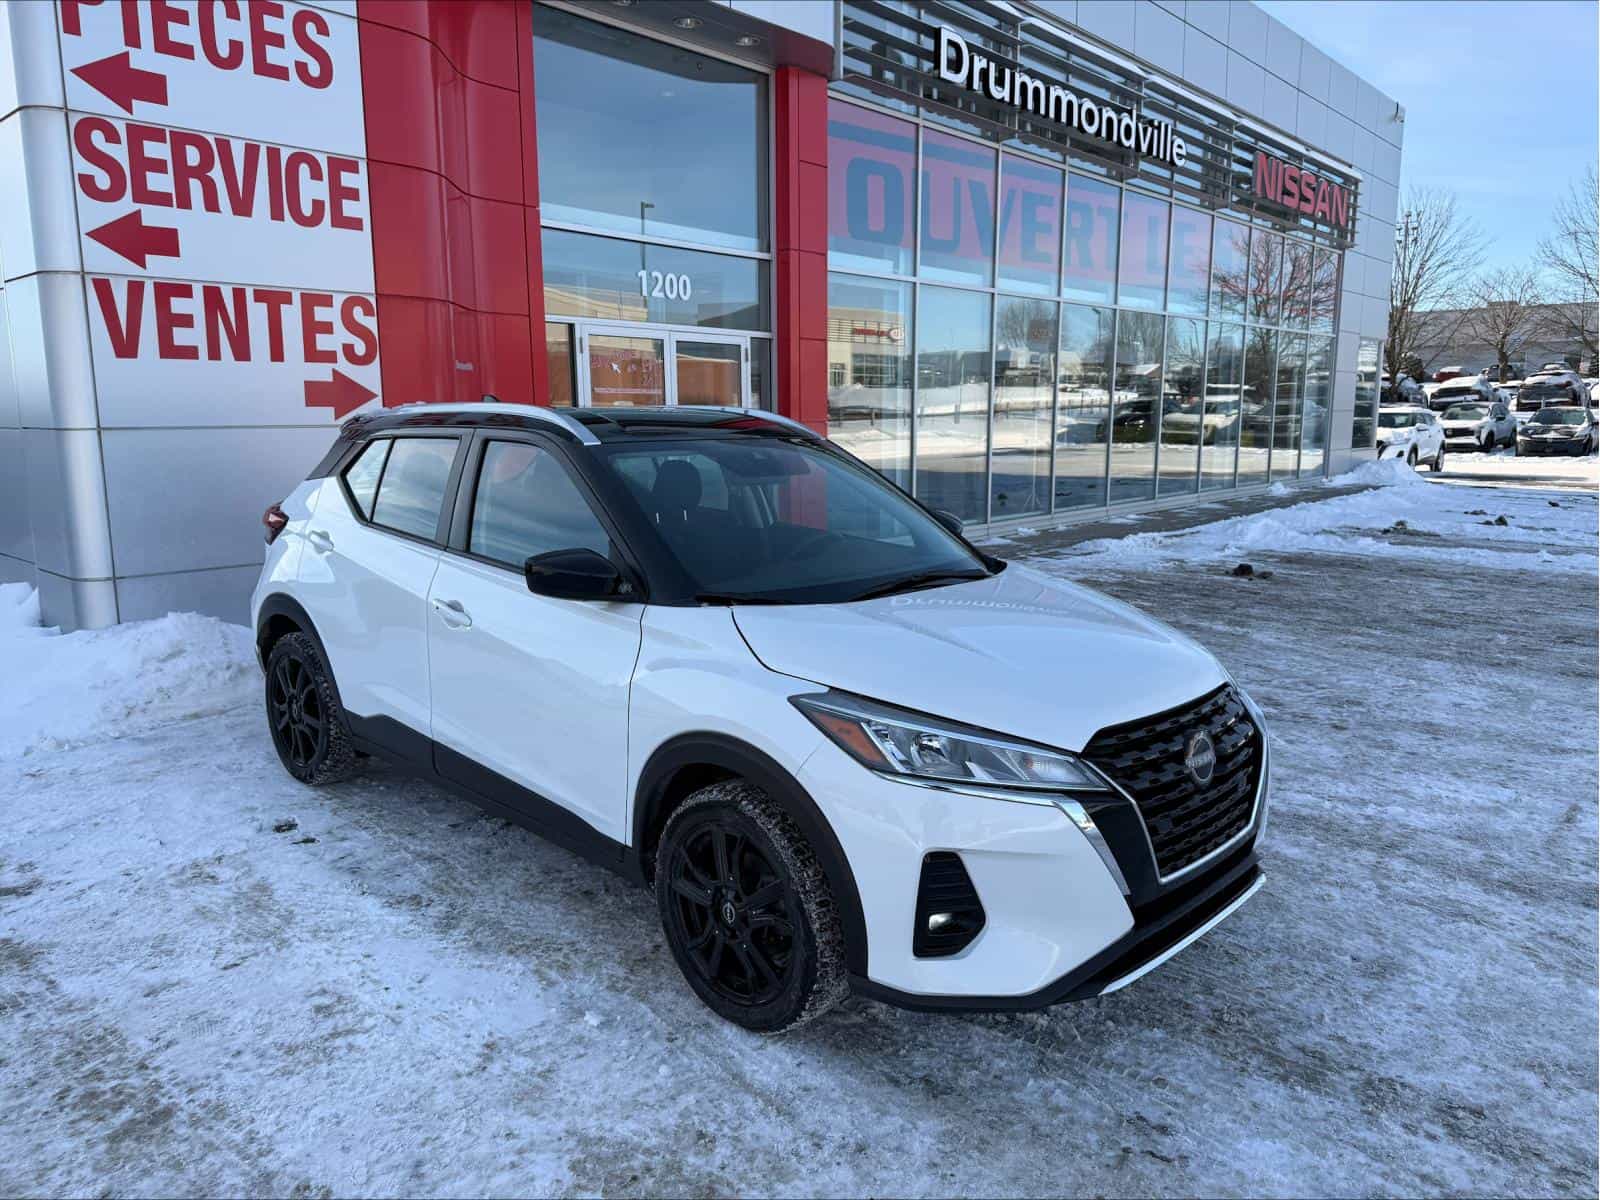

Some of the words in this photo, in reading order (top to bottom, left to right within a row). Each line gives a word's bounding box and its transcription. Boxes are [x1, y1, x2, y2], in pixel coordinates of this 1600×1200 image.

[939, 26, 1188, 167] Drummondville
[74, 117, 364, 232] SERVICE
[846, 156, 1128, 272] OUVERT
[1254, 151, 1348, 226] NISSAN
[92, 278, 378, 365] VENTES
[638, 270, 691, 301] 1200
